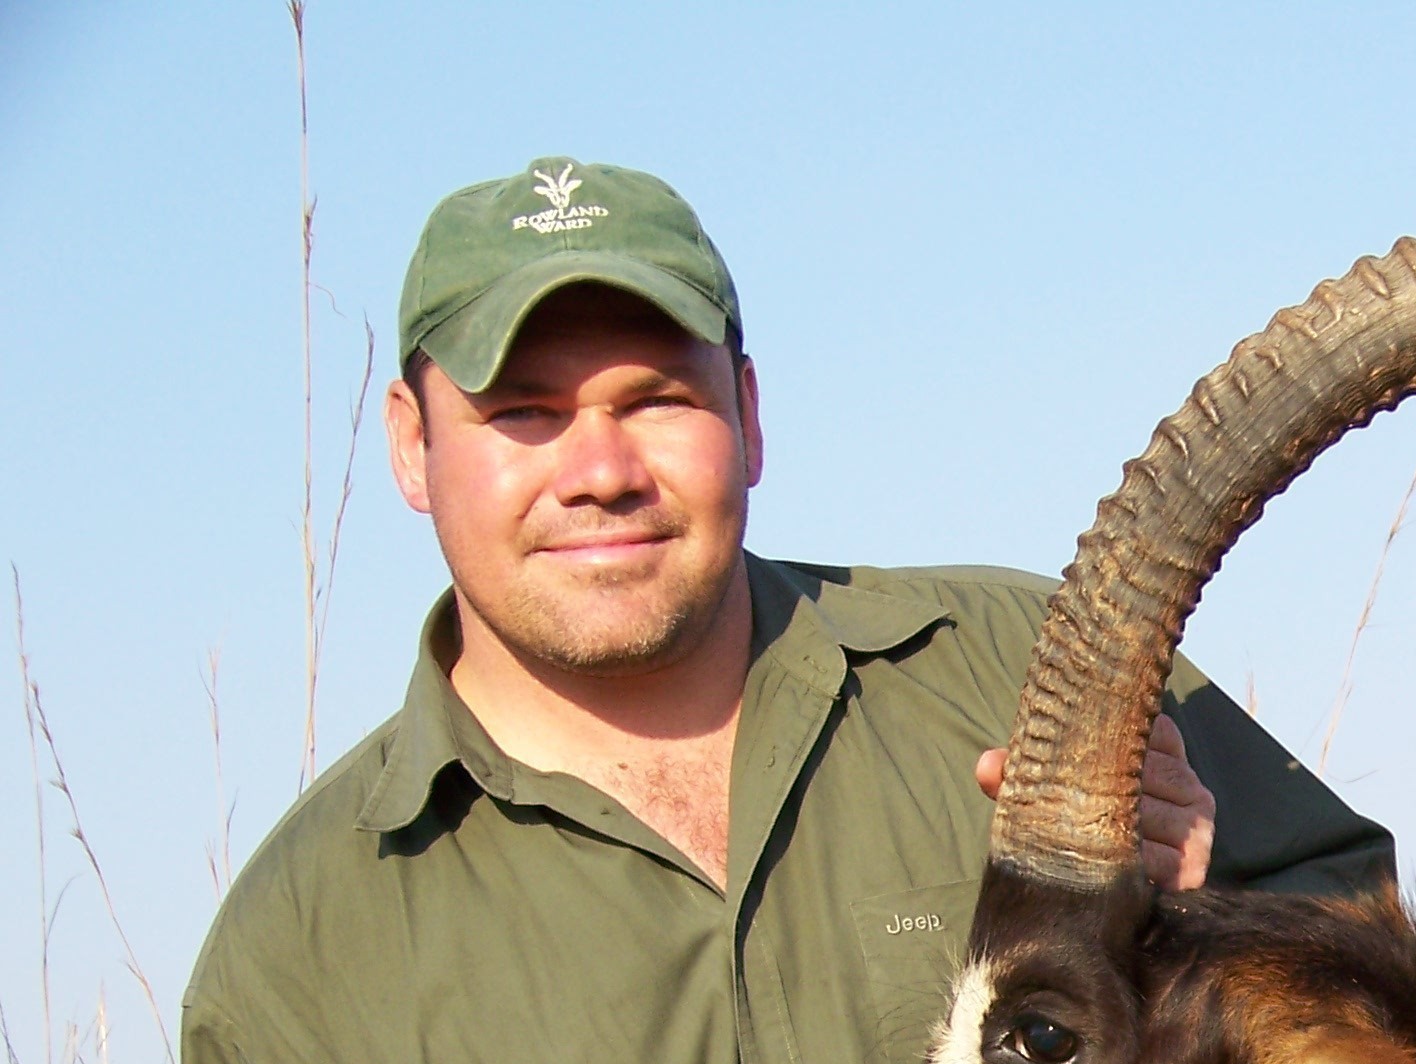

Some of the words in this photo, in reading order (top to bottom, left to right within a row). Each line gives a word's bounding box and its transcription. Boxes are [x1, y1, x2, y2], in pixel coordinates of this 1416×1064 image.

[512, 206, 609, 230] ROWLAND
[533, 219, 593, 234] WARD
[886, 914, 943, 934] Jeep
